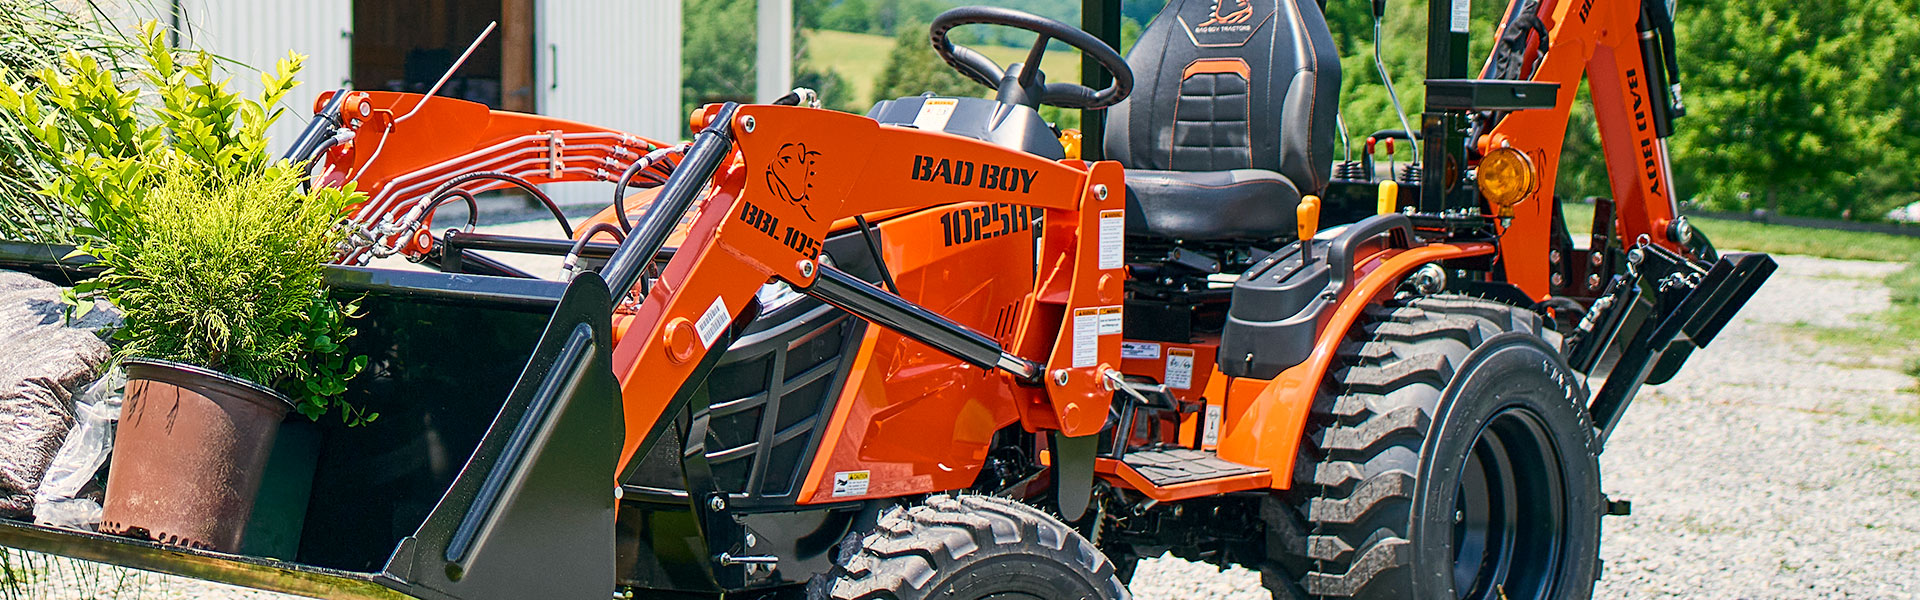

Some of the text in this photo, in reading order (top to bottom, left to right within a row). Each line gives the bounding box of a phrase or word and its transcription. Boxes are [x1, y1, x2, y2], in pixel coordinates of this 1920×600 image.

[1626, 68, 1662, 197] BAD BOY
[911, 154, 1039, 194] BAD BOY
[739, 201, 823, 261] BBL 105
